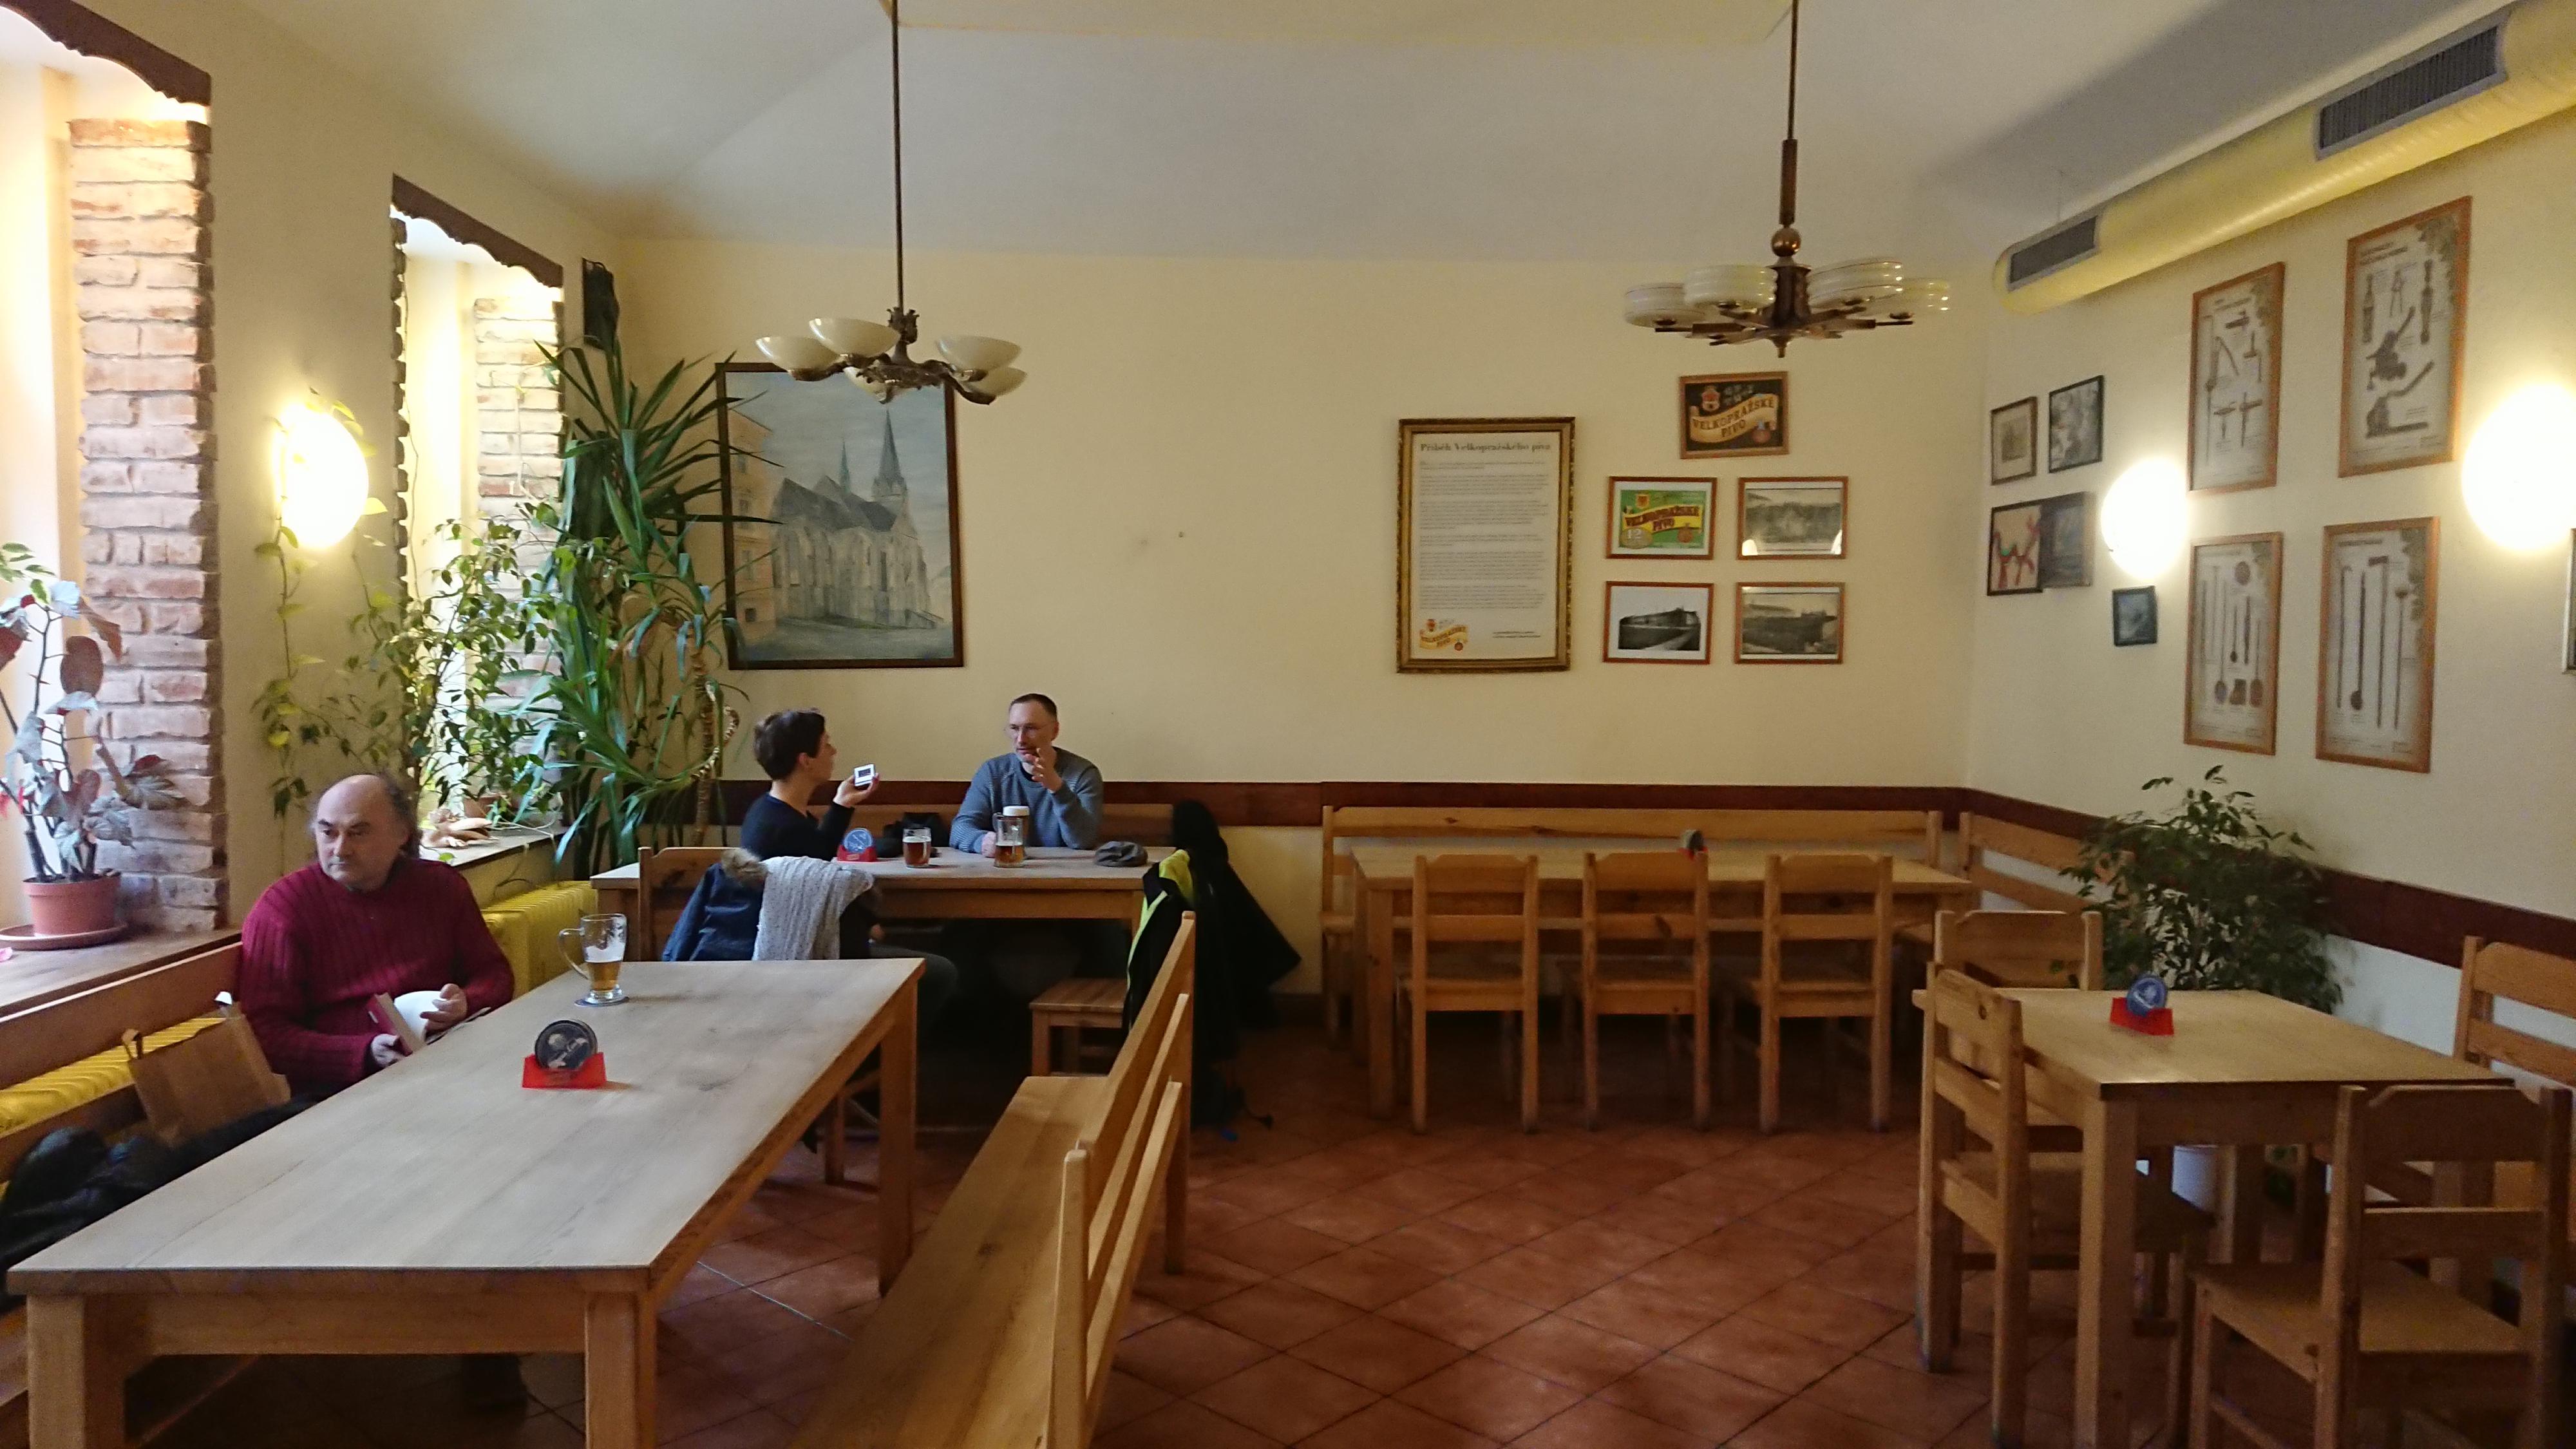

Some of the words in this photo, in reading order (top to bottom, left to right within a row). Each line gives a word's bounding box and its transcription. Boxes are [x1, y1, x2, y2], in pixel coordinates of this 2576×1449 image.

[1721, 419, 1747, 437] PIVO
[1653, 518, 1675, 531] PIVO
[1627, 528, 1642, 540] 12
